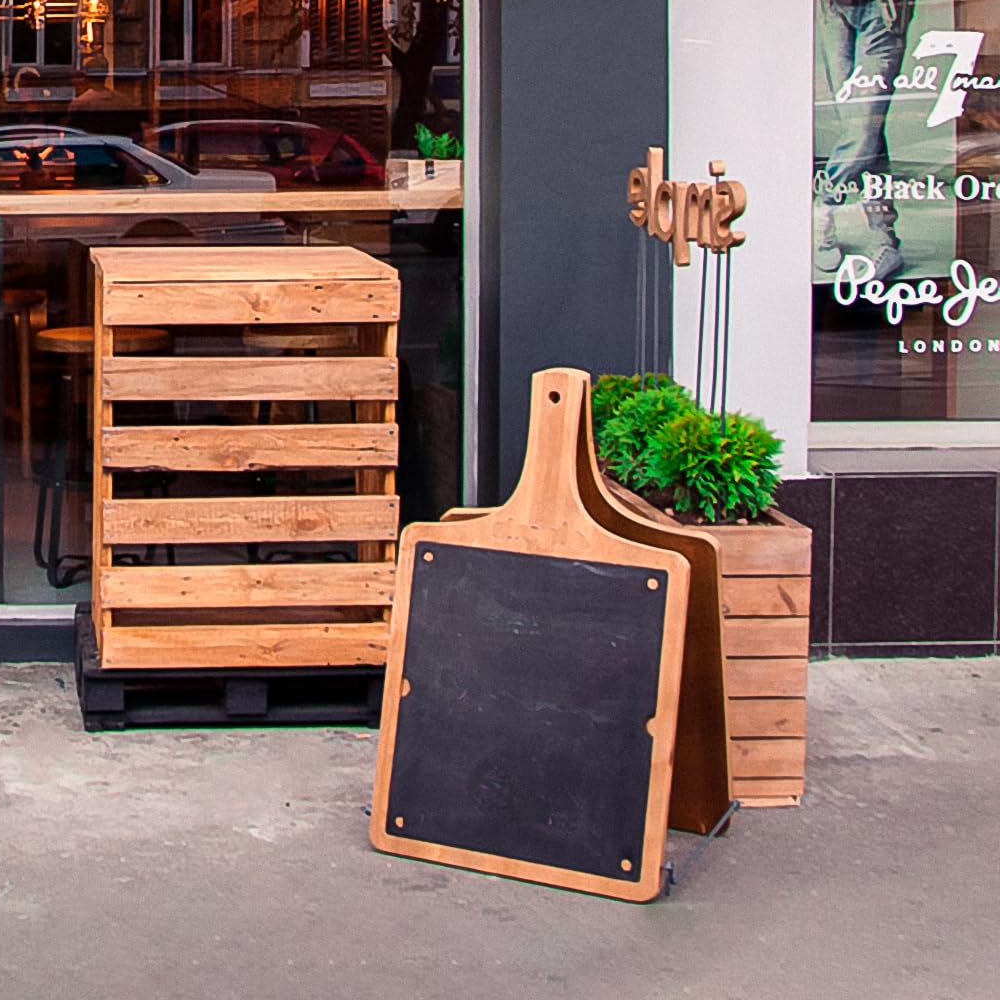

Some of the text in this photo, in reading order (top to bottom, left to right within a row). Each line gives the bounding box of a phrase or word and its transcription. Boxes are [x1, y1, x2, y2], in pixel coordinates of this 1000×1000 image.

[893, 66, 937, 90] all
[912, 30, 985, 128] 7
[952, 75, 1000, 90] ma
[864, 174, 946, 201] Black
[834, 254, 1000, 326] Pepe Je
[899, 339, 1000, 354] LONDON
